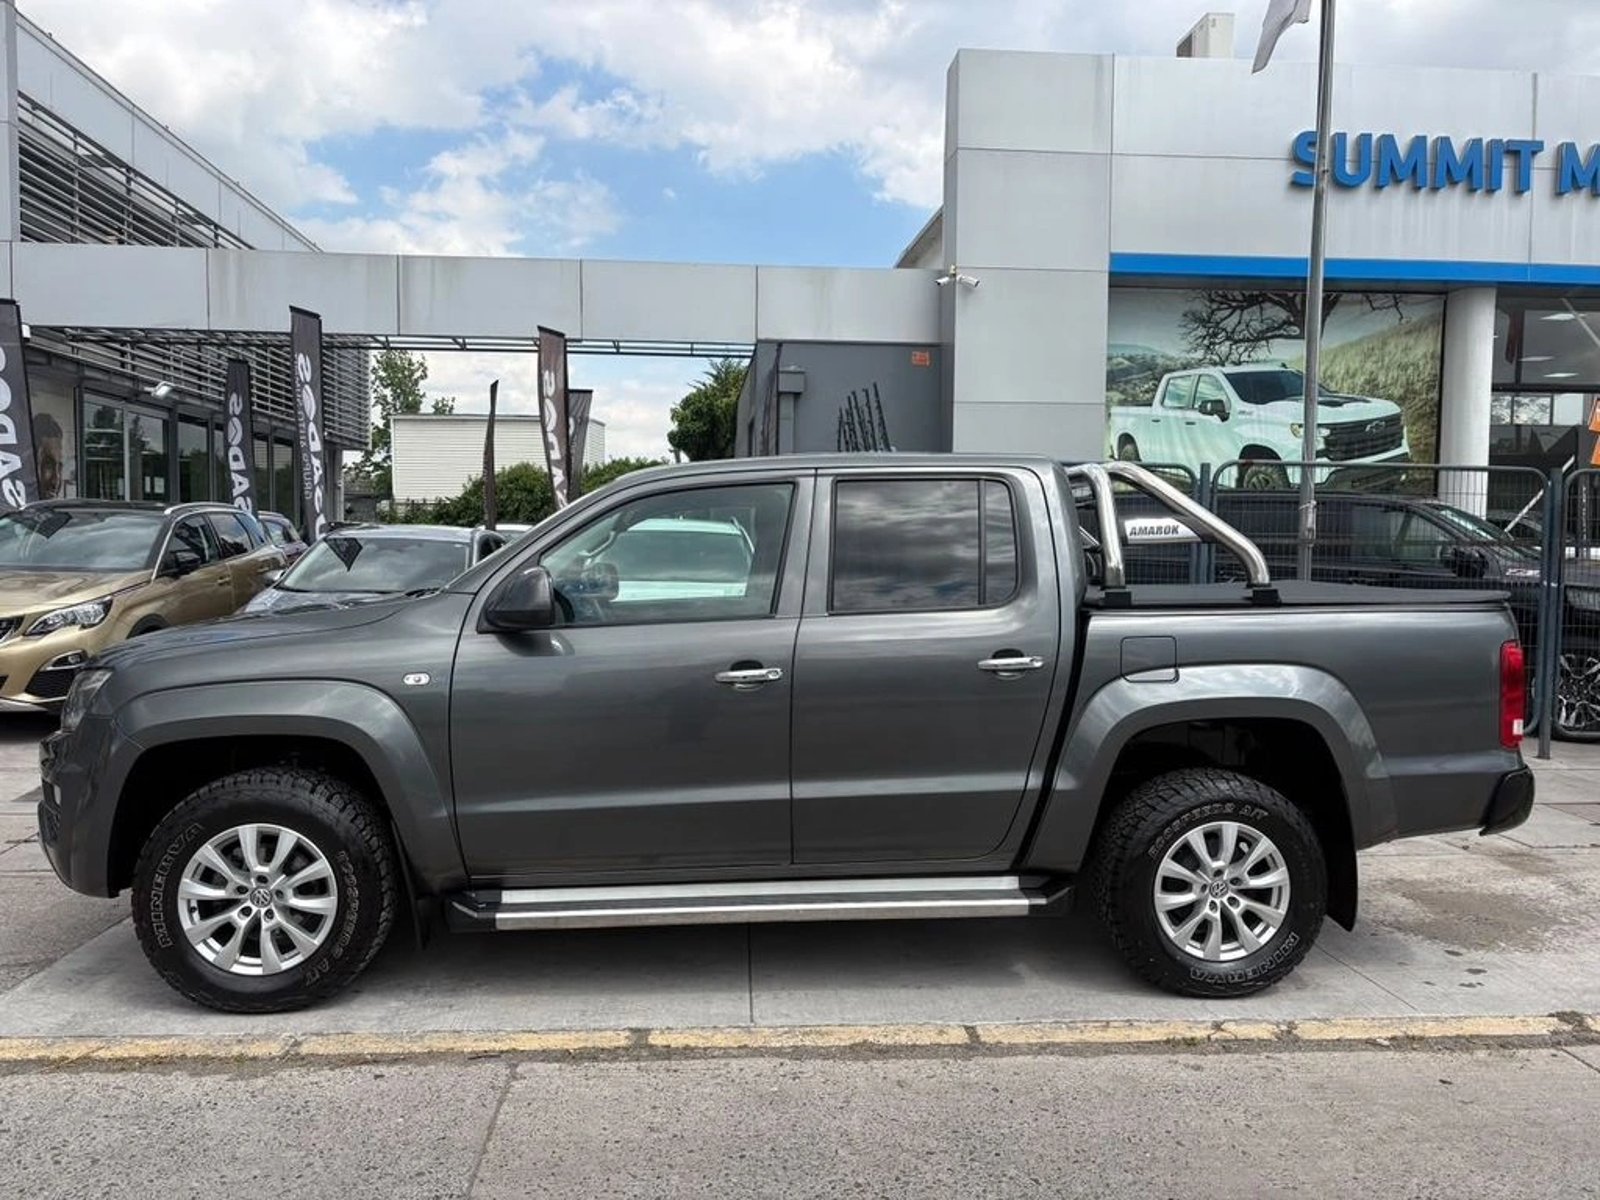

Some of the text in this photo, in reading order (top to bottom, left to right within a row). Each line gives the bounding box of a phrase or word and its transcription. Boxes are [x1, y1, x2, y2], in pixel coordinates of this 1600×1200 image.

[1291, 130, 1544, 193] SUMMIT
[1129, 524, 1180, 537] AMAROK
[149, 823, 206, 949] MINERVA
[1190, 932, 1300, 985] MINERVA
